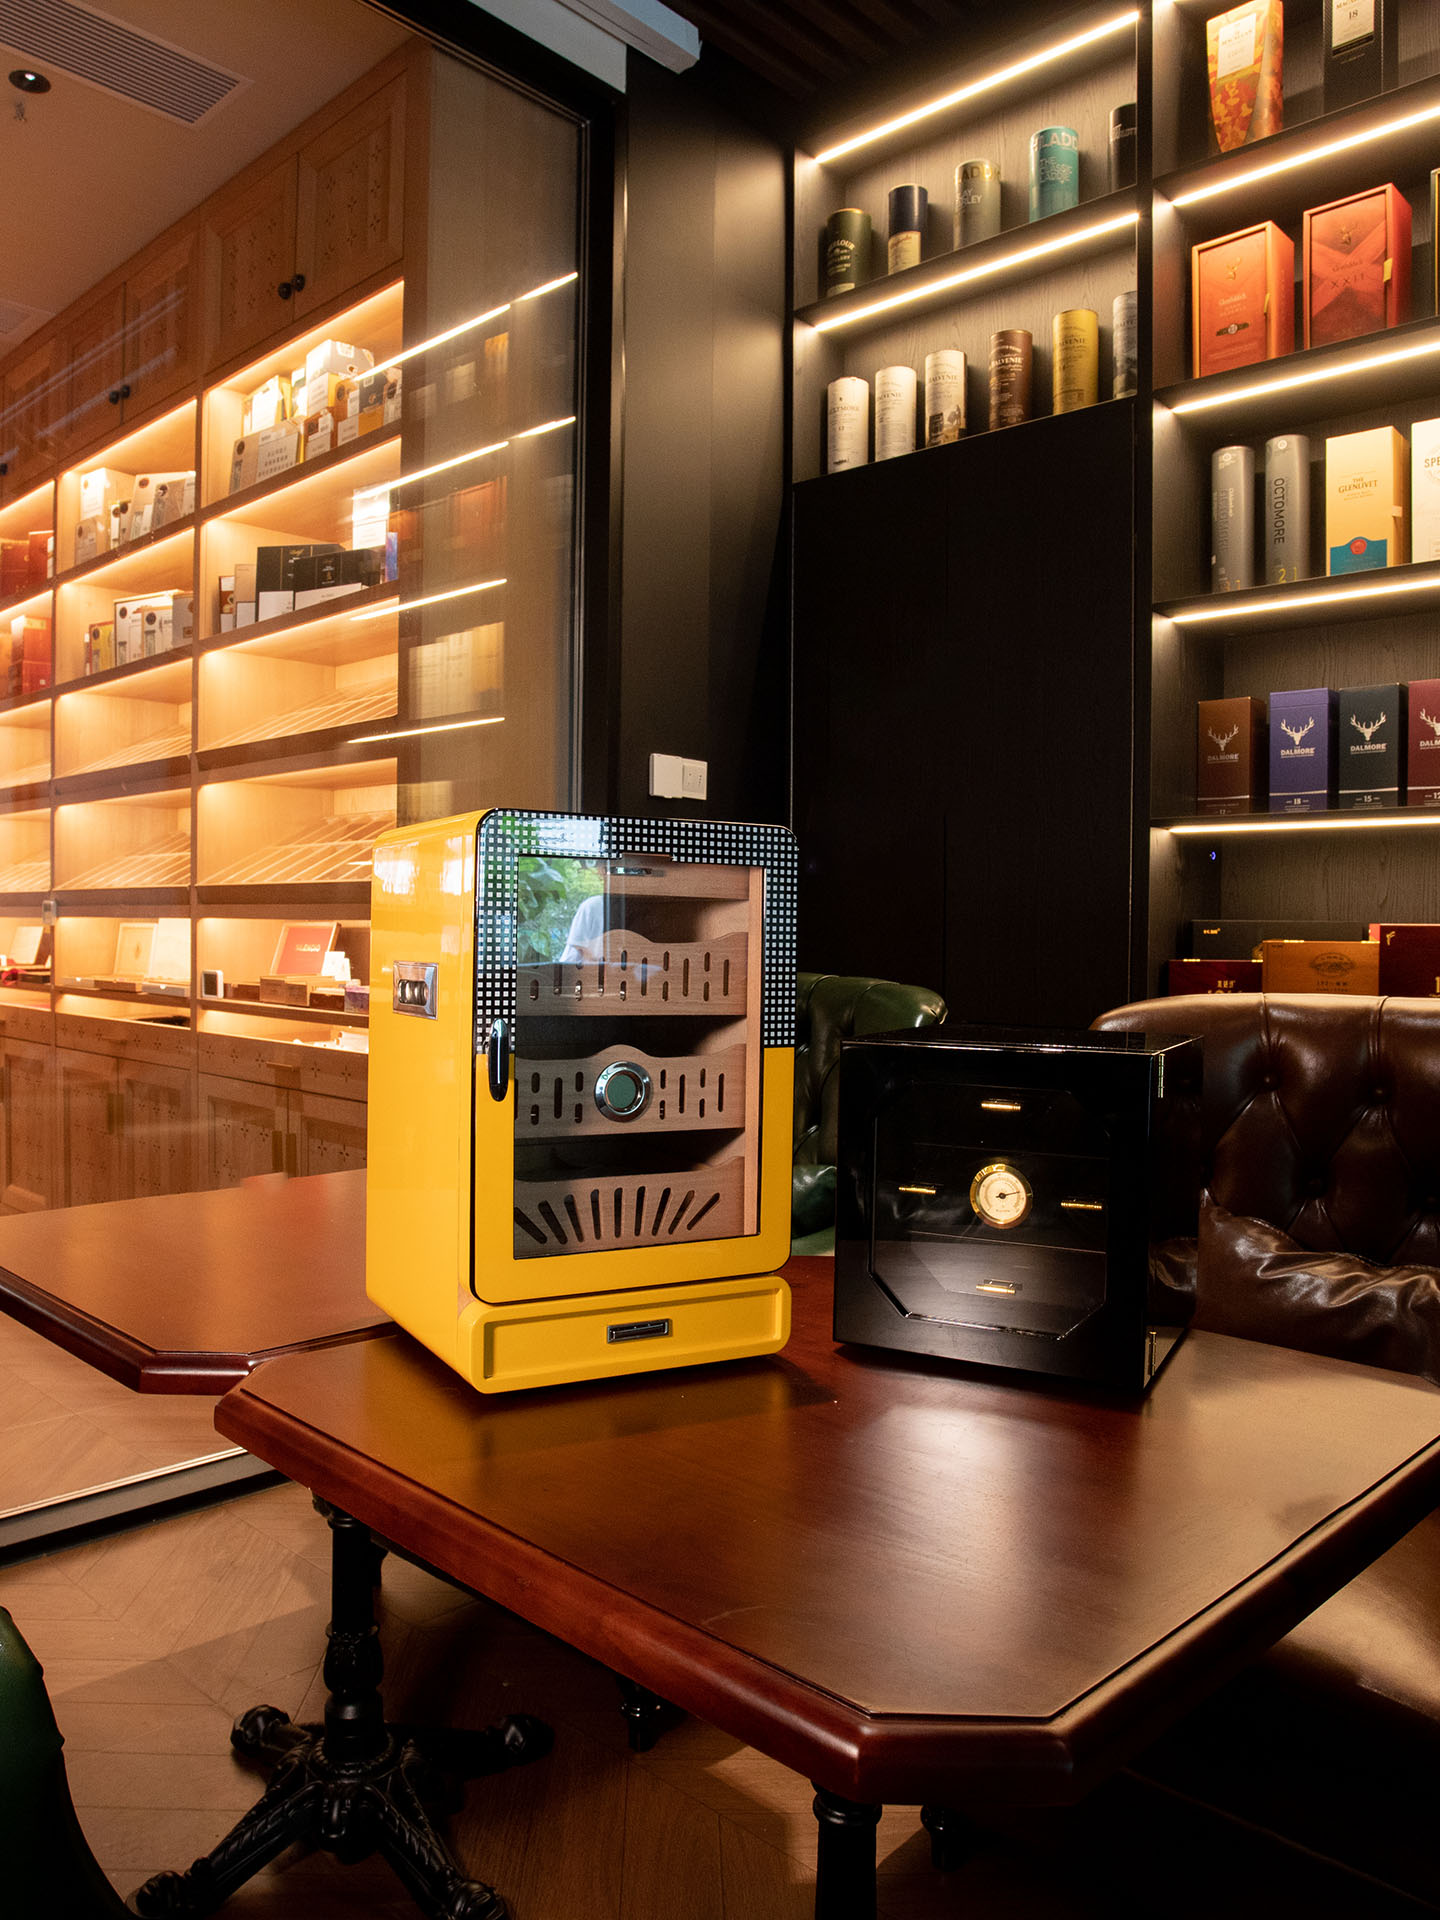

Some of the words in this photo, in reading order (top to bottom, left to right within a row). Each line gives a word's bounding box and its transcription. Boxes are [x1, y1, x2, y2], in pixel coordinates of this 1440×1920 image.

[1338, 480, 1378, 494] GLENLIVET
[1273, 478, 1286, 545] OCTOMORE
[1280, 747, 1316, 756] DALMORE
[1350, 743, 1388, 752] DALMORE
